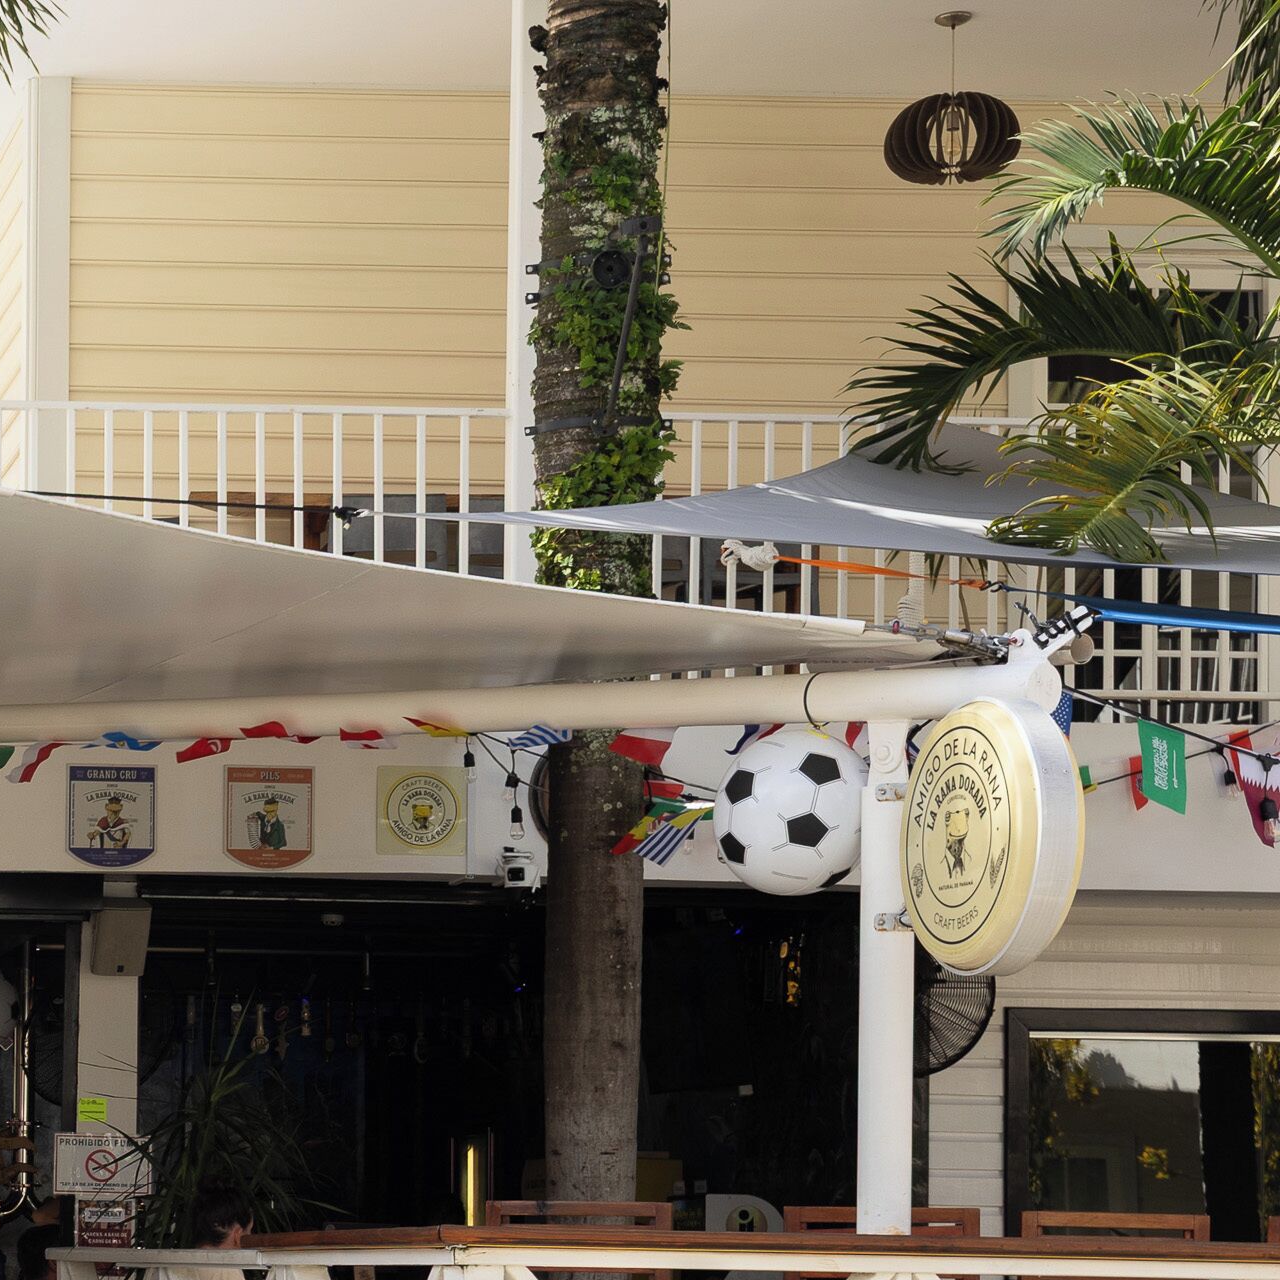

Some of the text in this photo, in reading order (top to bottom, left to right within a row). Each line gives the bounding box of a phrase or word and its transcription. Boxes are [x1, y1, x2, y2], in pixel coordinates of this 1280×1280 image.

[87, 769, 137, 780] GRAND CRU
[260, 771, 280, 780] PILS
[914, 738, 1002, 828] AMIGO DE LA RANA
[401, 780, 442, 791] CRAFT BEERS
[927, 774, 987, 831] LA RANA DORADA
[392, 818, 452, 843] AMIGO DE LA RANA
[934, 905, 978, 930] CRAFT BEERS
[59, 1138, 109, 1147] PROHIBIDO
